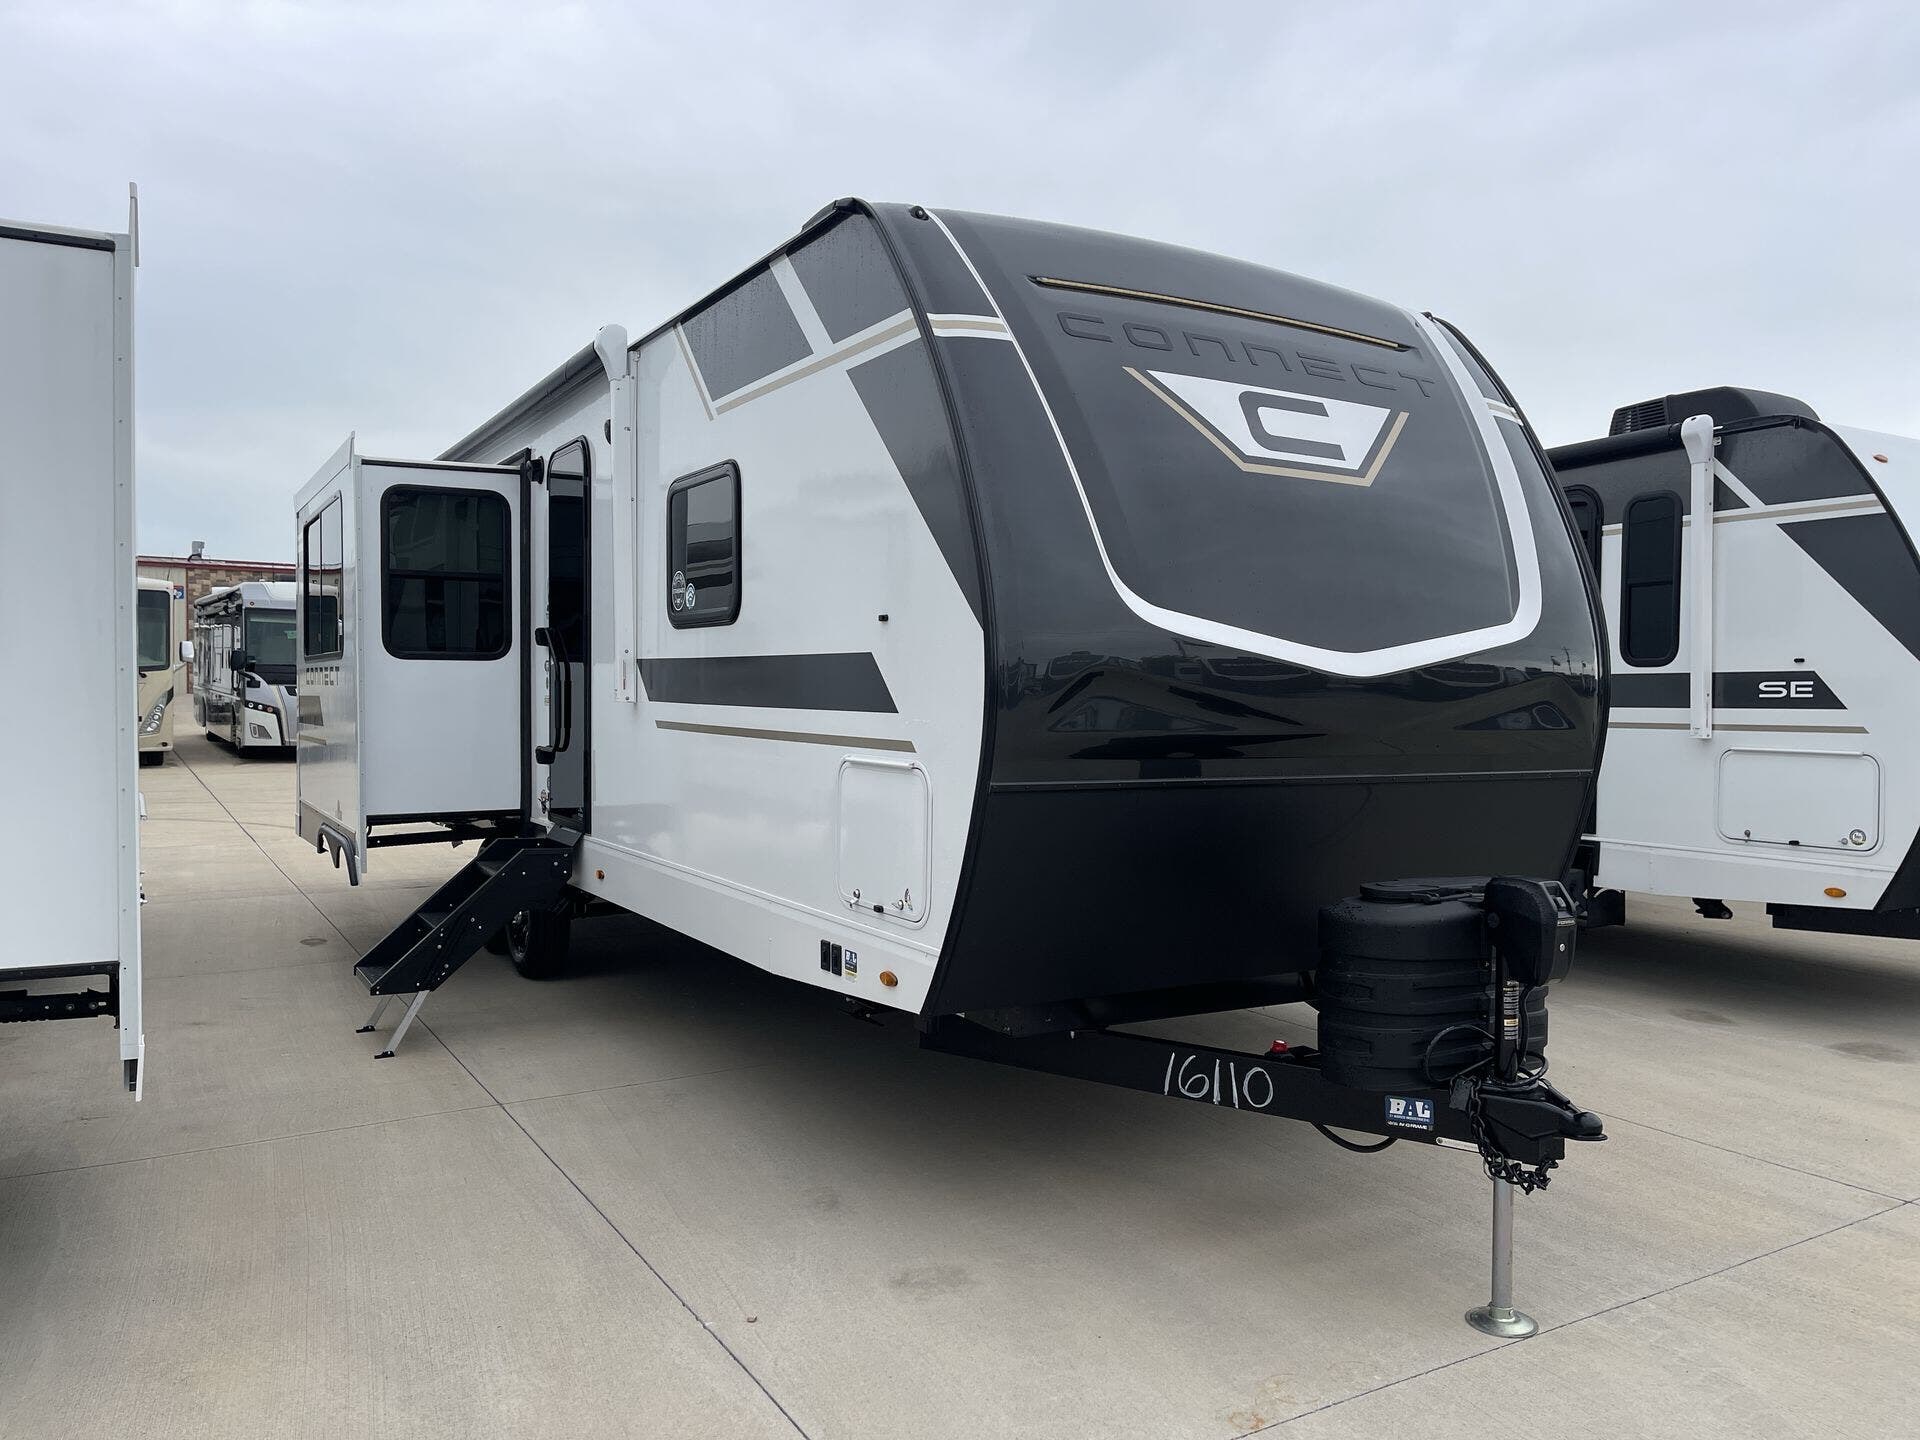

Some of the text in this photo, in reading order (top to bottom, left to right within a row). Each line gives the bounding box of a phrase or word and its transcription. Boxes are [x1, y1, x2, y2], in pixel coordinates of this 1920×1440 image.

[1056, 311, 1435, 398] CONNECT
[1758, 681, 1814, 698] SE
[1164, 1052, 1274, 1109] 16110
[1389, 1098, 1431, 1119] BAL
